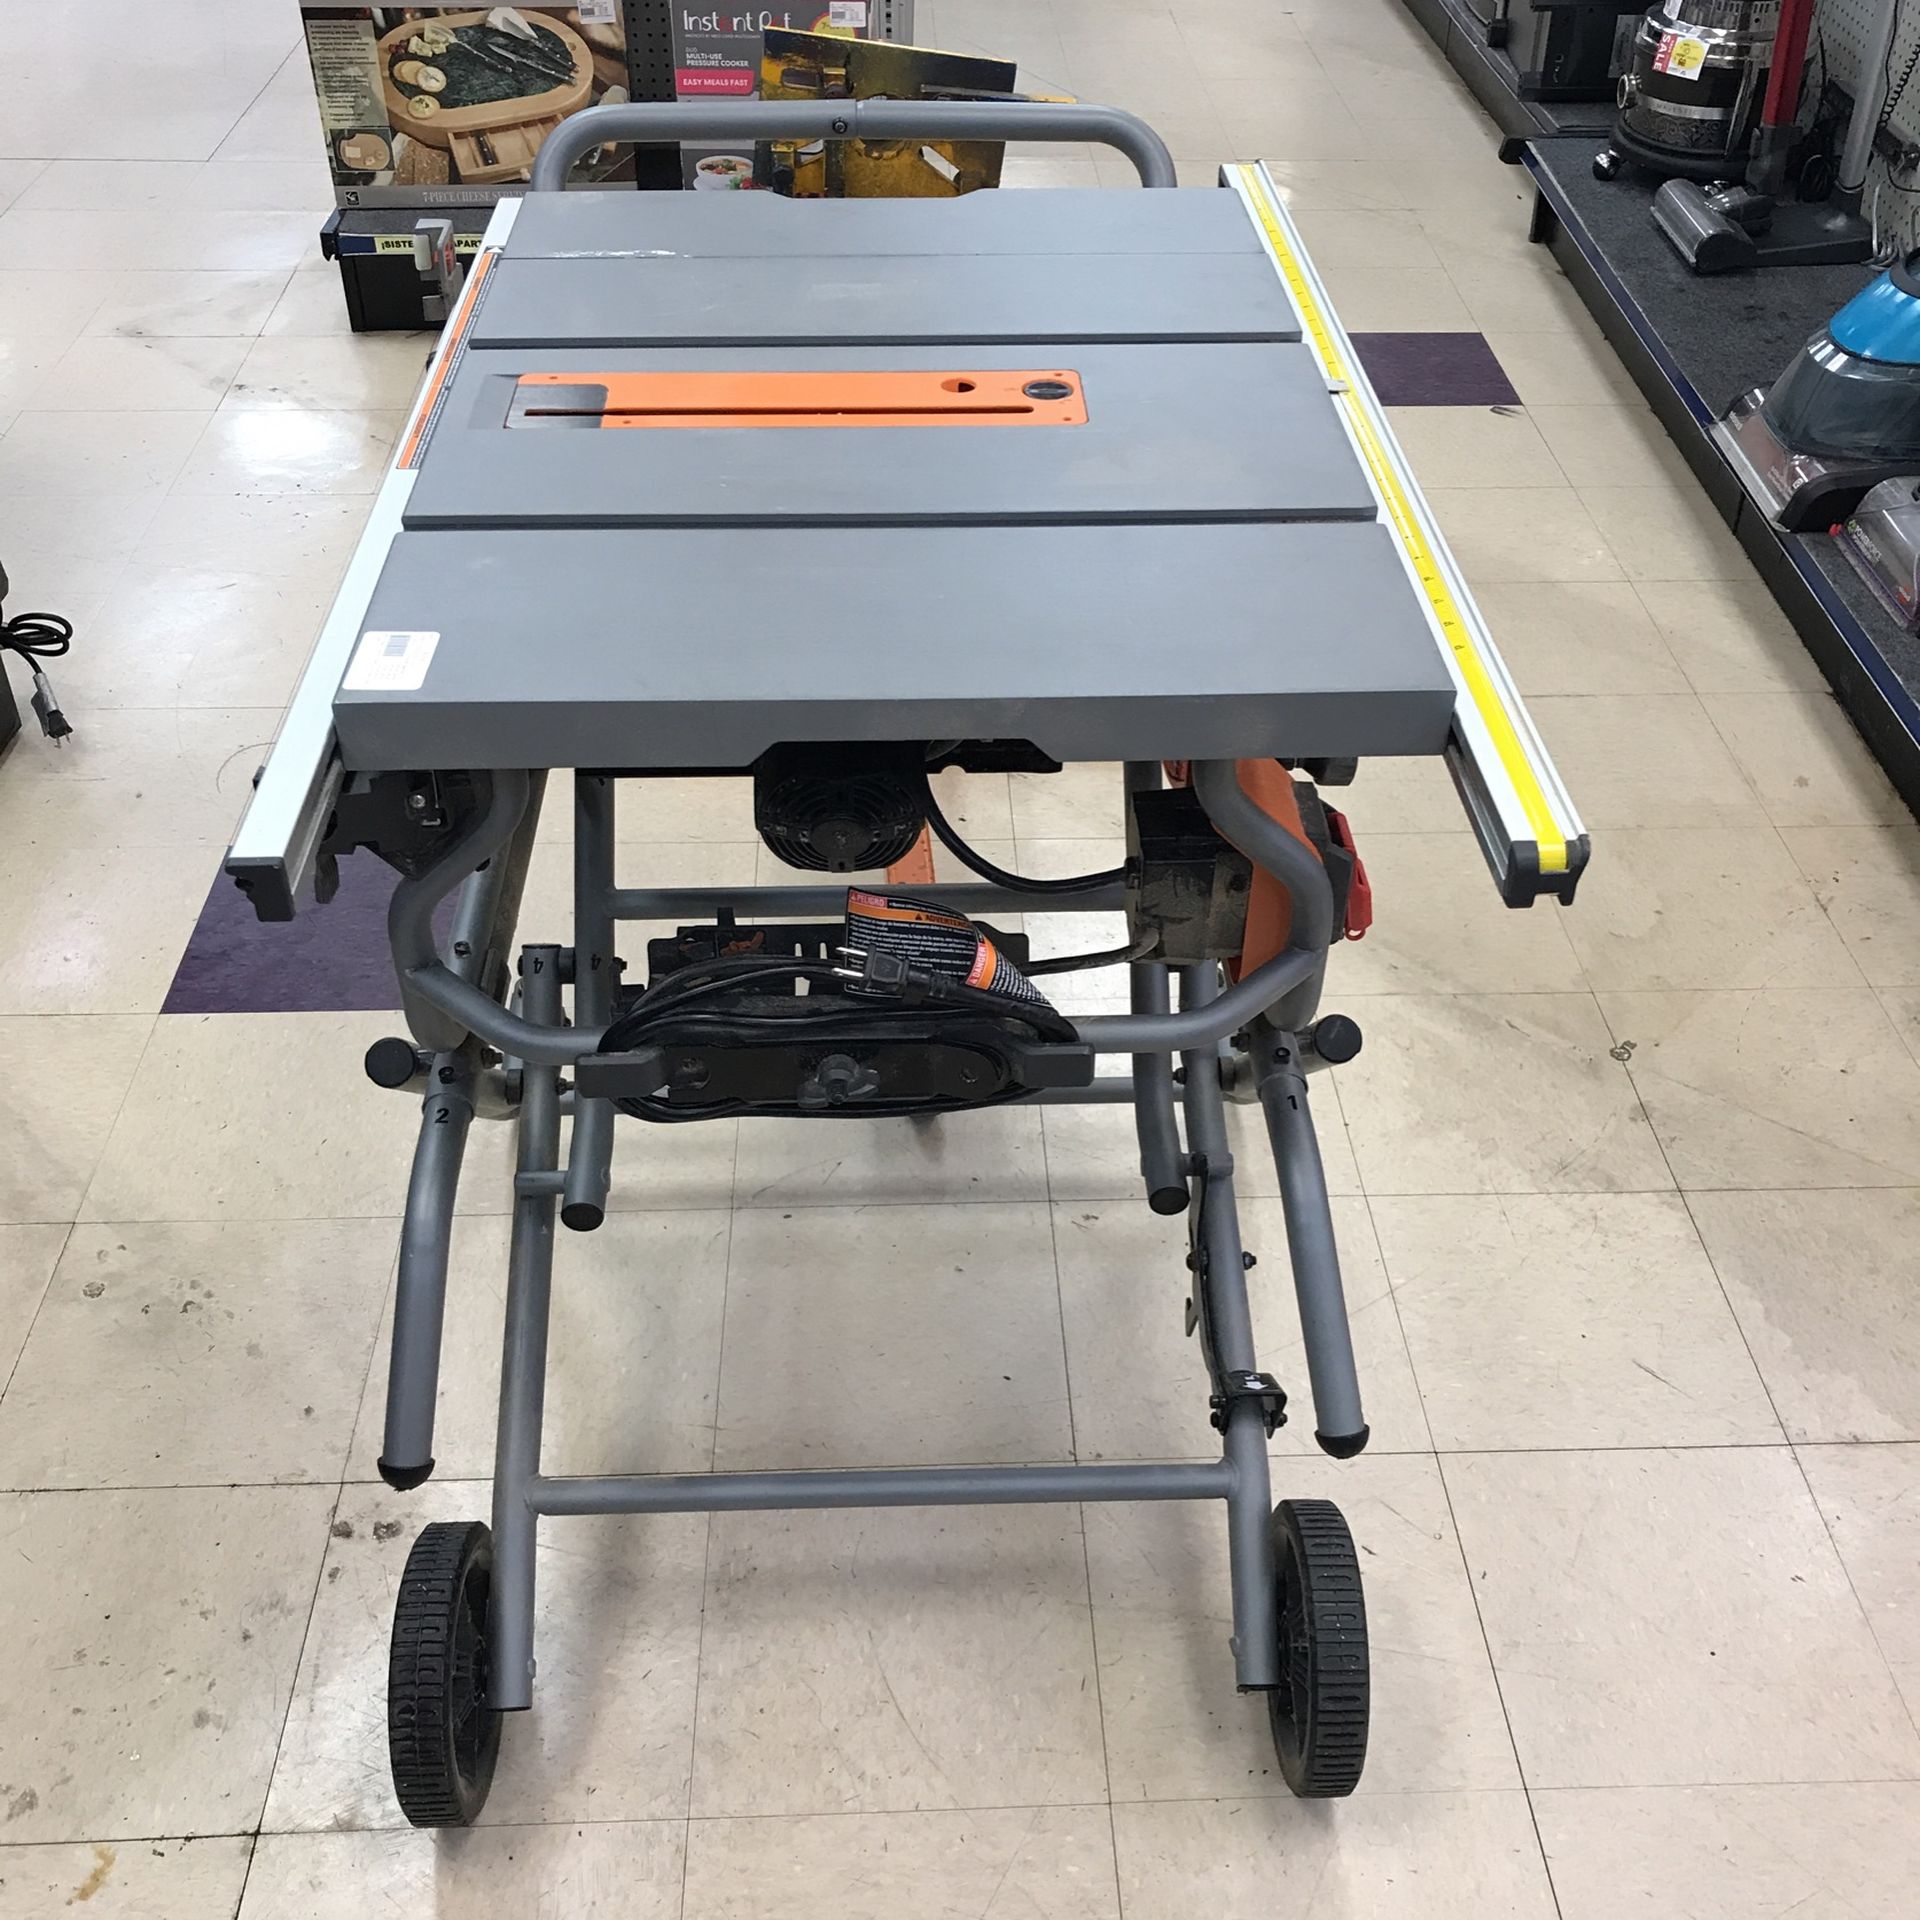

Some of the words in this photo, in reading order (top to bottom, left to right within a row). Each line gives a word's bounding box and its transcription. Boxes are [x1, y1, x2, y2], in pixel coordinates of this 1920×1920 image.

[1653, 33, 1672, 71] SALE
[683, 78, 702, 86] EASY
[703, 79, 729, 87] MEALS
[730, 79, 748, 87] FAST
[422, 191, 456, 203] 7-PIECE
[456, 191, 491, 203] CHEESE
[856, 894, 885, 907] PELIGRO
[533, 957, 544, 974] 4
[974, 945, 987, 981] DANGER
[434, 1107, 450, 1124] 2
